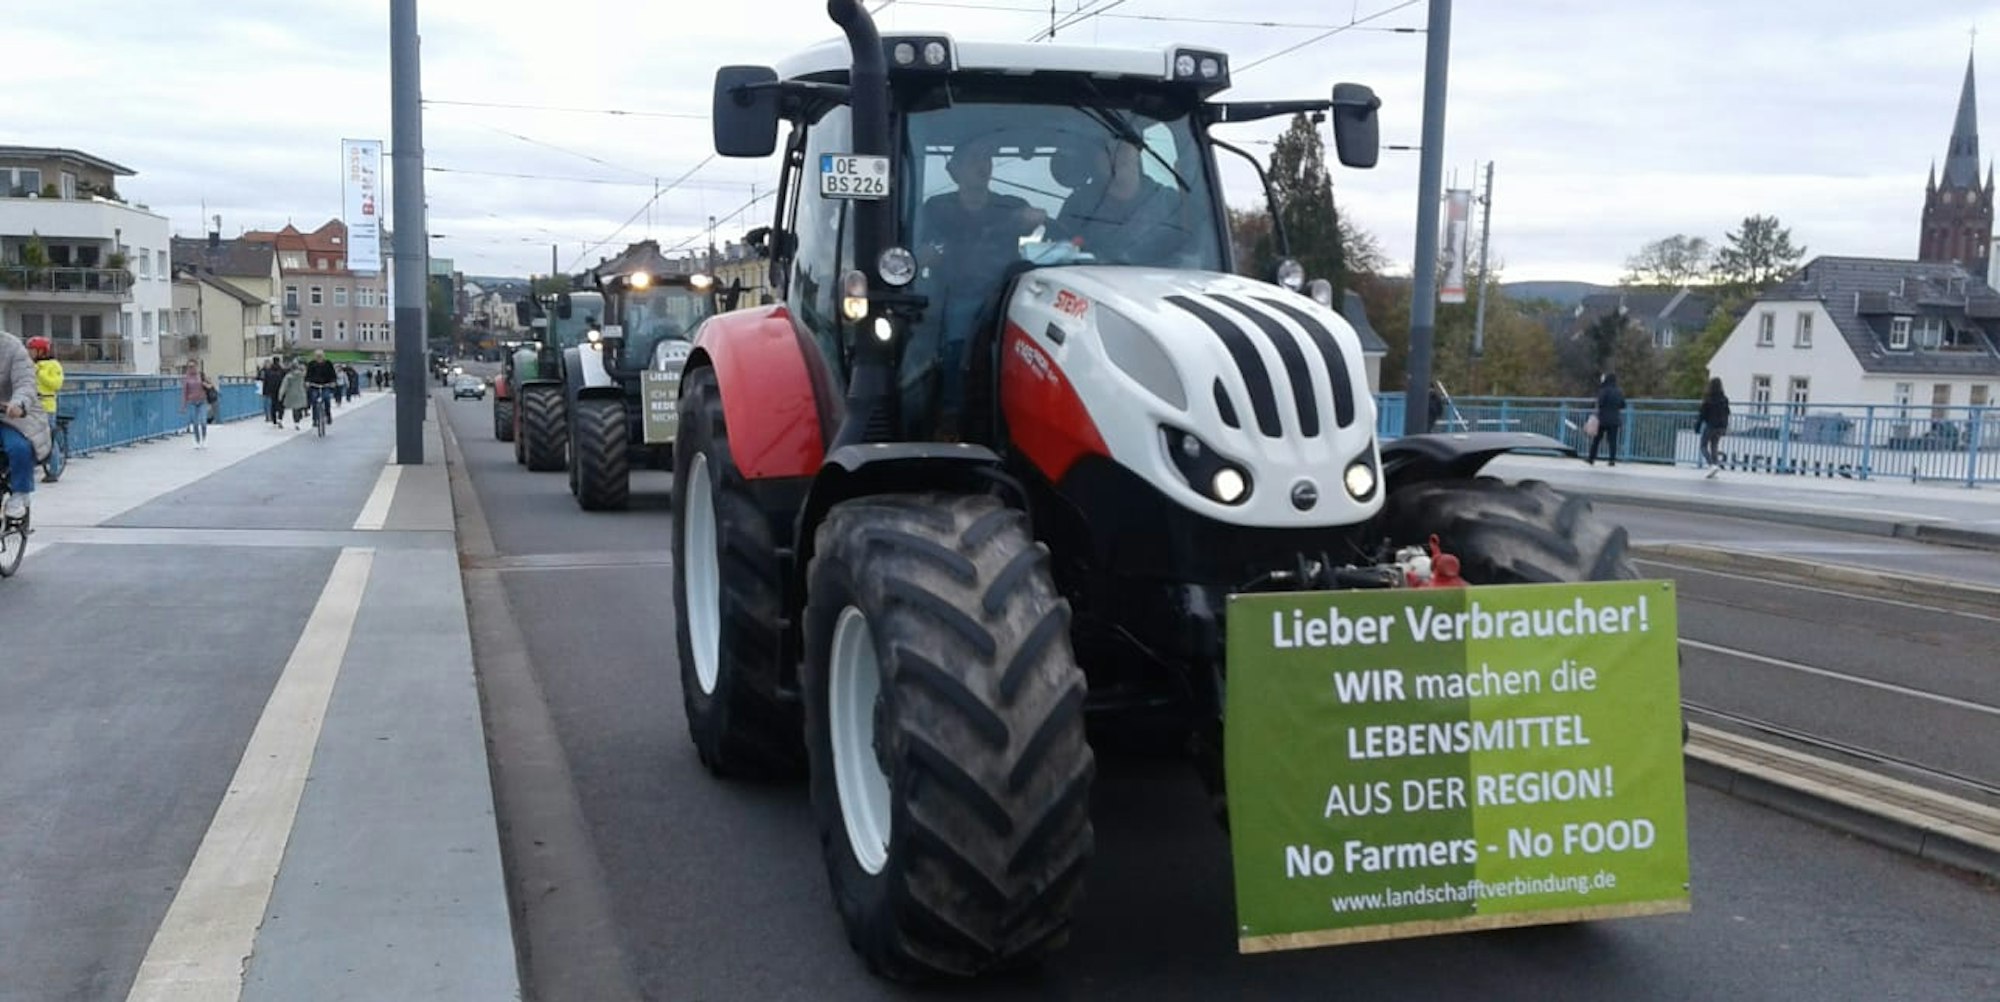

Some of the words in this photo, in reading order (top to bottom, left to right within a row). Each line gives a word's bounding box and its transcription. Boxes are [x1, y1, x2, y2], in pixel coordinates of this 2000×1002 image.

[827, 175, 849, 192] BS
[853, 177, 884, 193] 226
[836, 158, 858, 174] OE
[1053, 288, 1089, 320] STEYR
[1273, 607, 1394, 648] Lieber
[1405, 596, 1650, 642] Verbraucher!
[1334, 669, 1405, 703] WIR
[1415, 664, 1541, 699] machen
[1551, 660, 1597, 692] die
[1348, 715, 1590, 759] LEBENSMITTEL
[1324, 783, 1393, 818] AUS
[1402, 777, 1467, 811] DER
[1476, 766, 1614, 806] REGION!
[1286, 844, 1334, 877] No
[1345, 836, 1478, 873] Farmers
[1508, 828, 1553, 859] No
[1563, 819, 1655, 854] FOOD
[1332, 871, 1616, 912] www.landschafftverbindung.de
